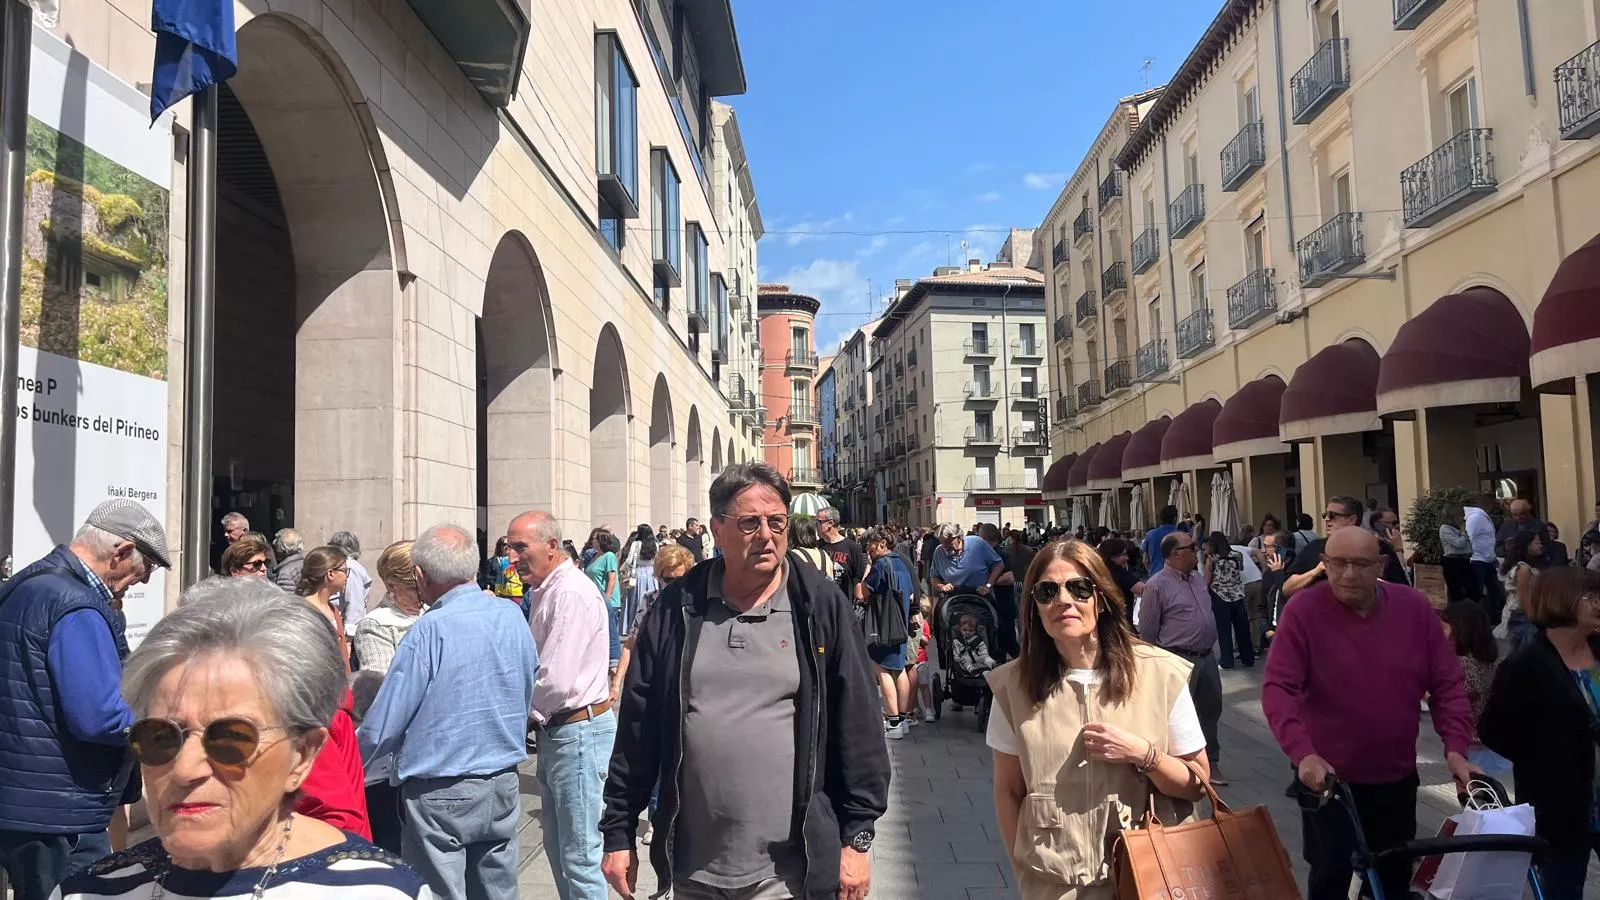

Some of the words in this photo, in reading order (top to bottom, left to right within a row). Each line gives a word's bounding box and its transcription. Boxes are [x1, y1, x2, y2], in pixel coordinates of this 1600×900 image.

[17, 376, 43, 394] nea
[47, 378, 57, 396] P
[32, 403, 90, 430] bunkers
[93, 415, 113, 434] del
[116, 418, 160, 441] Pirineo
[1038, 398, 1047, 446] HOSTAL
[108, 485, 127, 497] Iñaki
[128, 487, 157, 501] Bergera
[1180, 859, 1229, 883] THE
